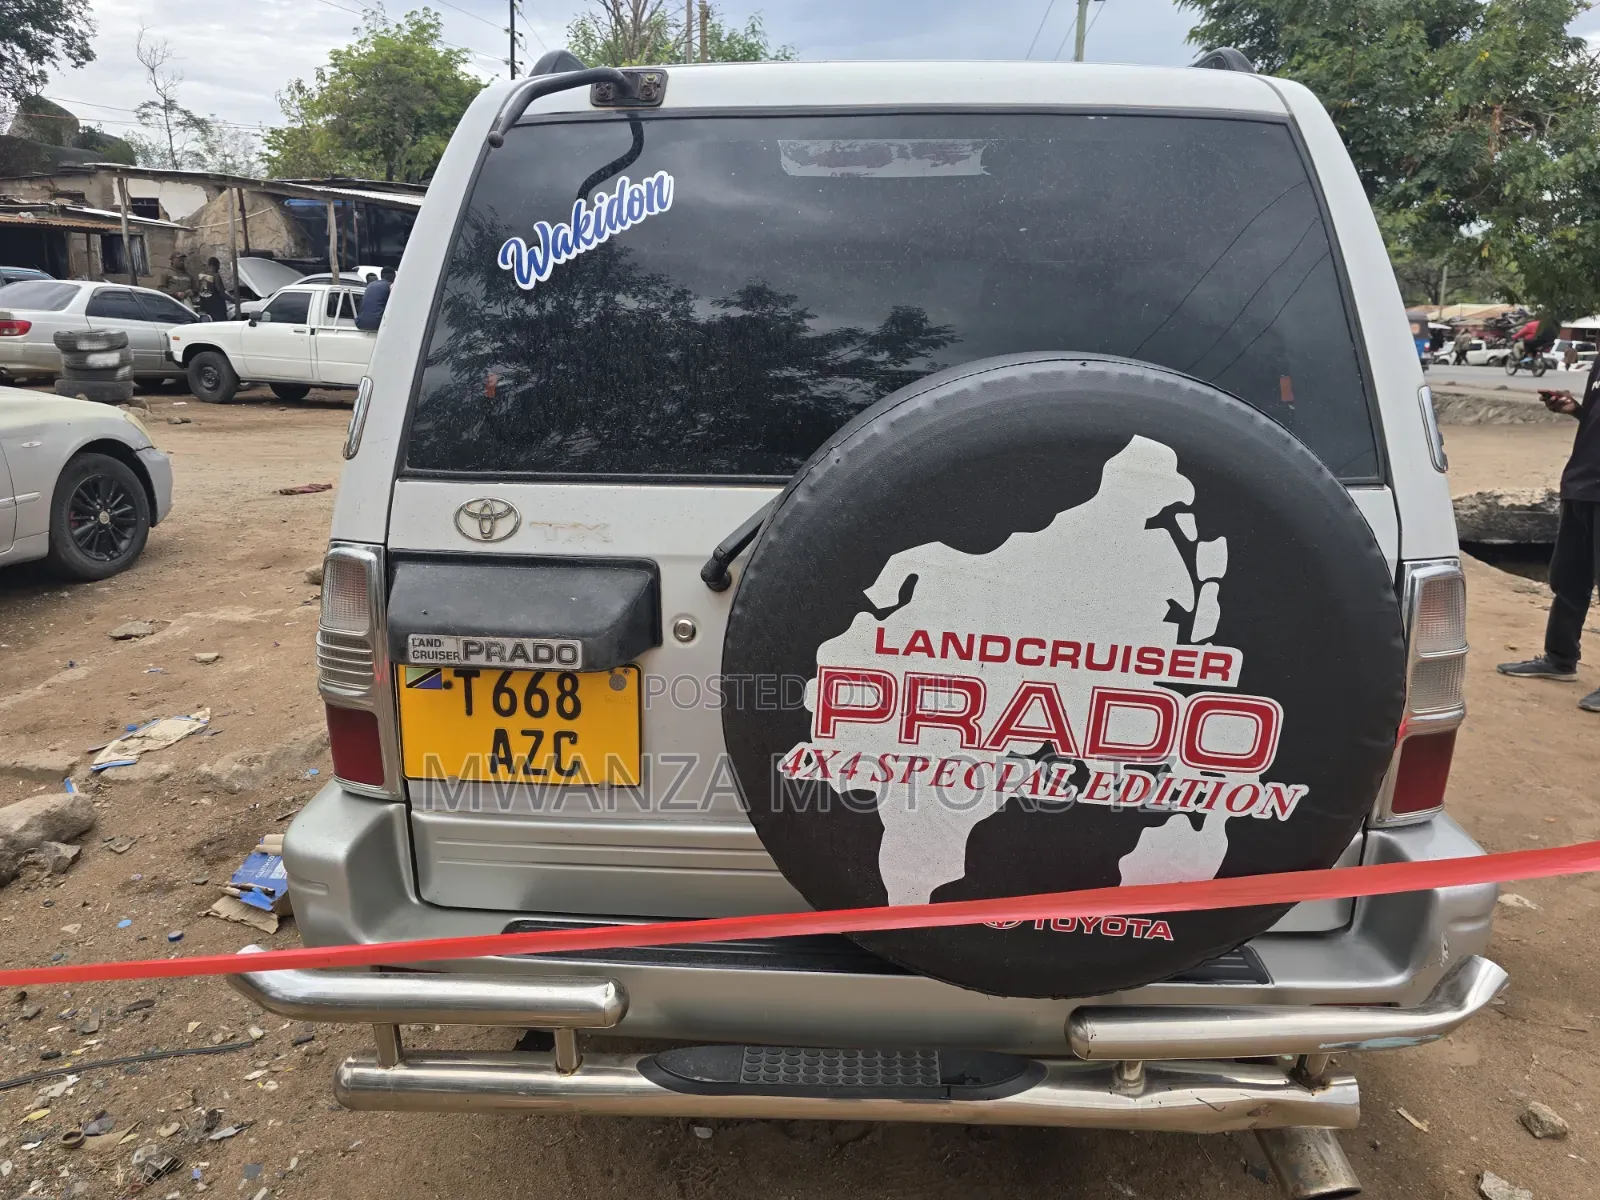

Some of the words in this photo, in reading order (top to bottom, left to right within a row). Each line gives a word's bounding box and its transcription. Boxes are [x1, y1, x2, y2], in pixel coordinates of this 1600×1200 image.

[498, 171, 674, 289] Wakidon
[412, 638, 442, 648] LAND
[412, 650, 460, 661] CRUISER
[462, 639, 579, 666] PRADO
[875, 627, 1234, 683] LANDCRUISER
[454, 669, 481, 717] T
[492, 671, 582, 721] 668
[814, 666, 1281, 774] PRADO
[488, 728, 581, 778] AZC
[781, 746, 862, 780] 4X4
[870, 752, 1073, 800] SPECIAL
[1083, 770, 1302, 817] EDITION
